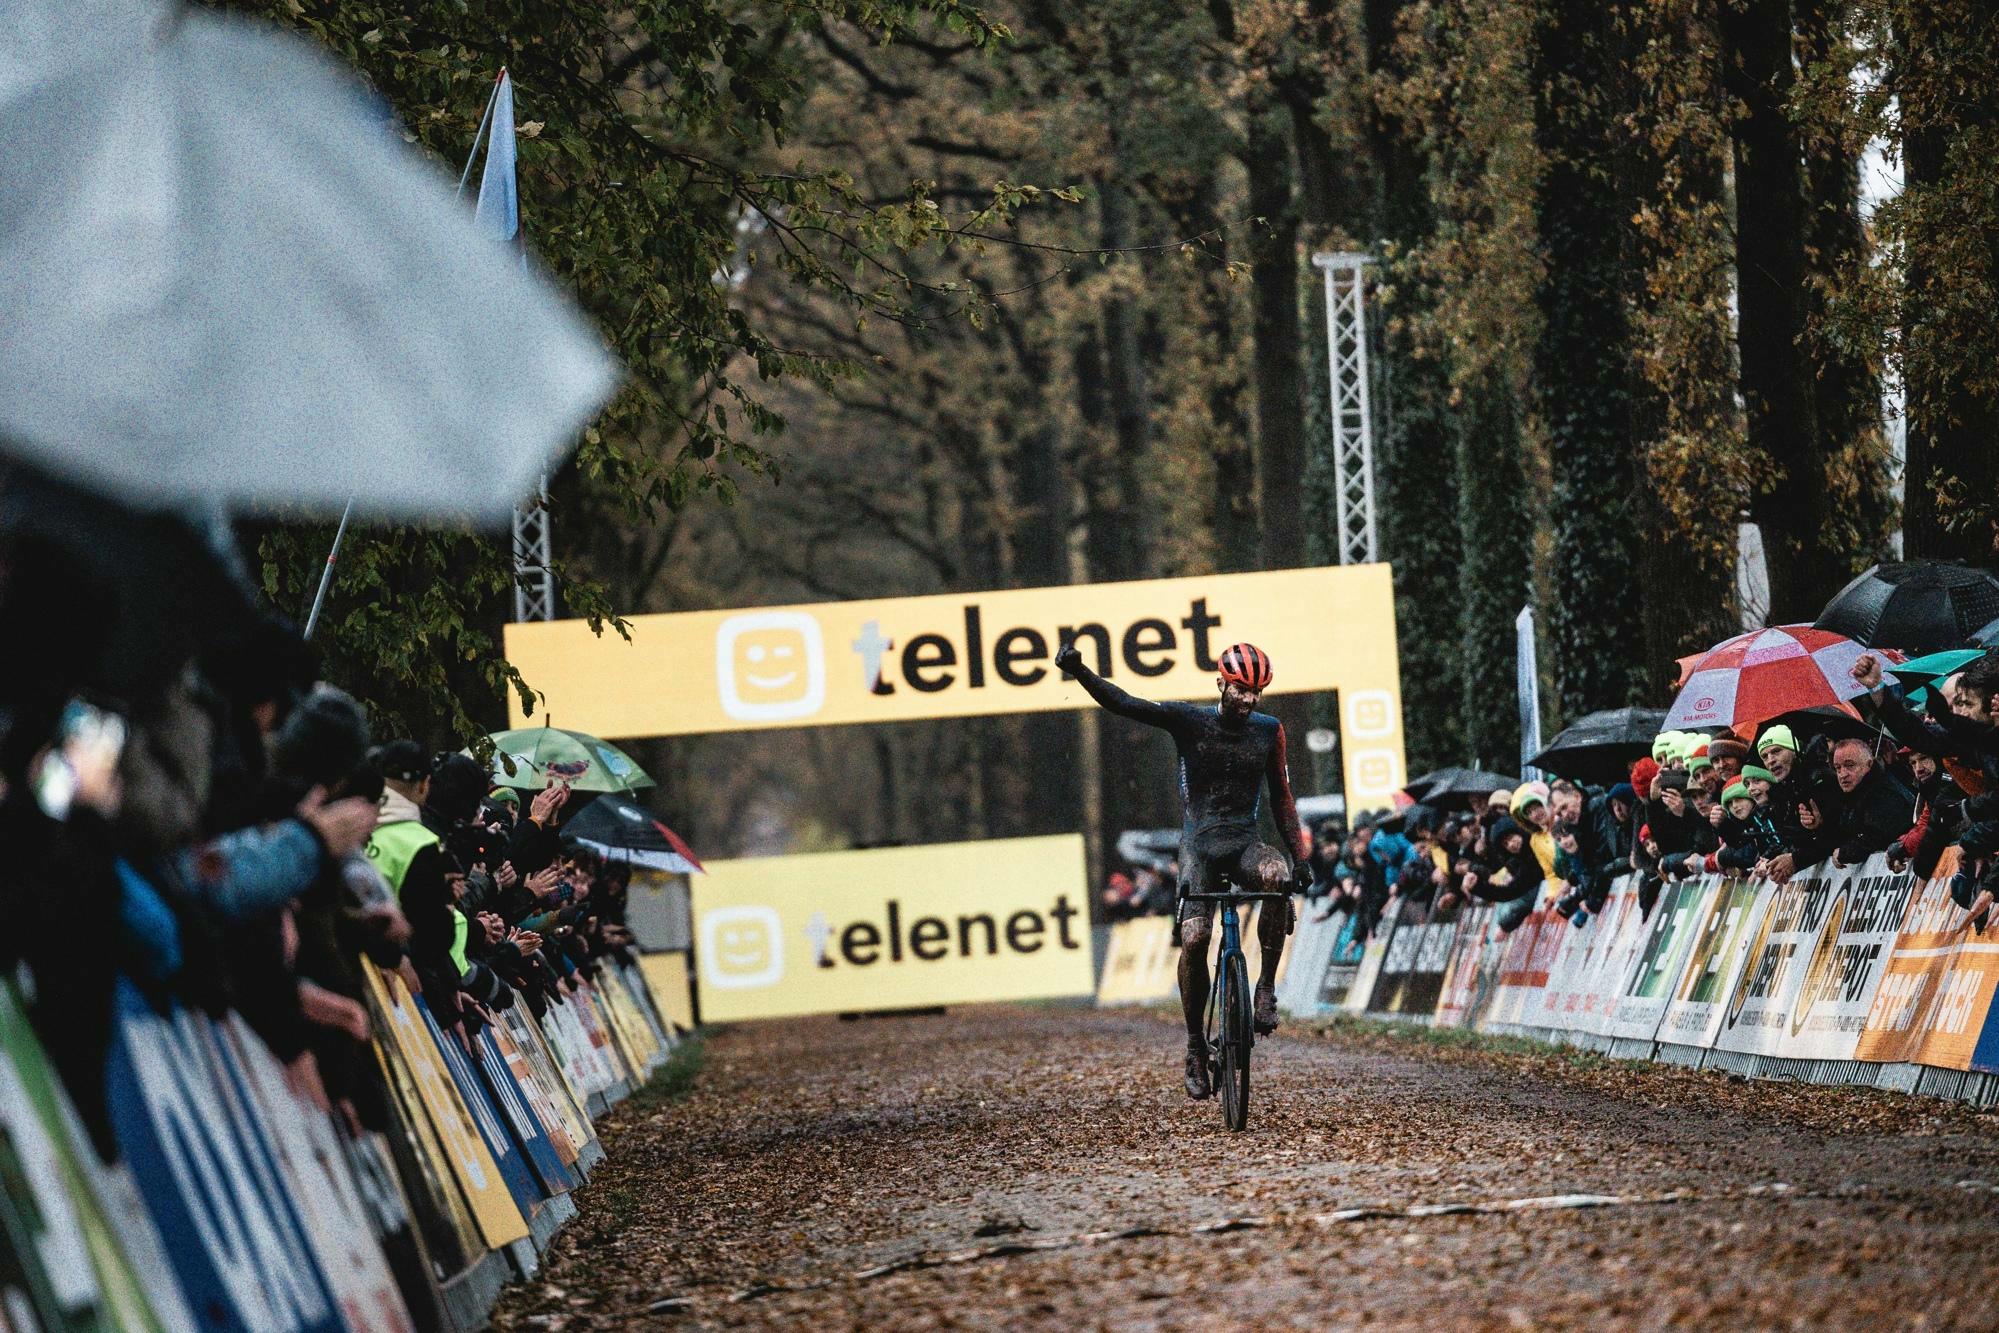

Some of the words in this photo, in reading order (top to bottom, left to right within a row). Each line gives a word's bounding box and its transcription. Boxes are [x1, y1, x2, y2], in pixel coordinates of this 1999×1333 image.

[851, 597, 1222, 696] telenet
[804, 894, 1079, 968] telenet
[1772, 878, 1831, 934] ELECTRO
[1843, 875, 1918, 934] ELECTRO
[1749, 944, 1797, 999] DEPOT
[1819, 943, 1882, 1003] DEPOT
[1922, 968, 1984, 1034] TOCK
[1867, 972, 1929, 1032] STOCK
